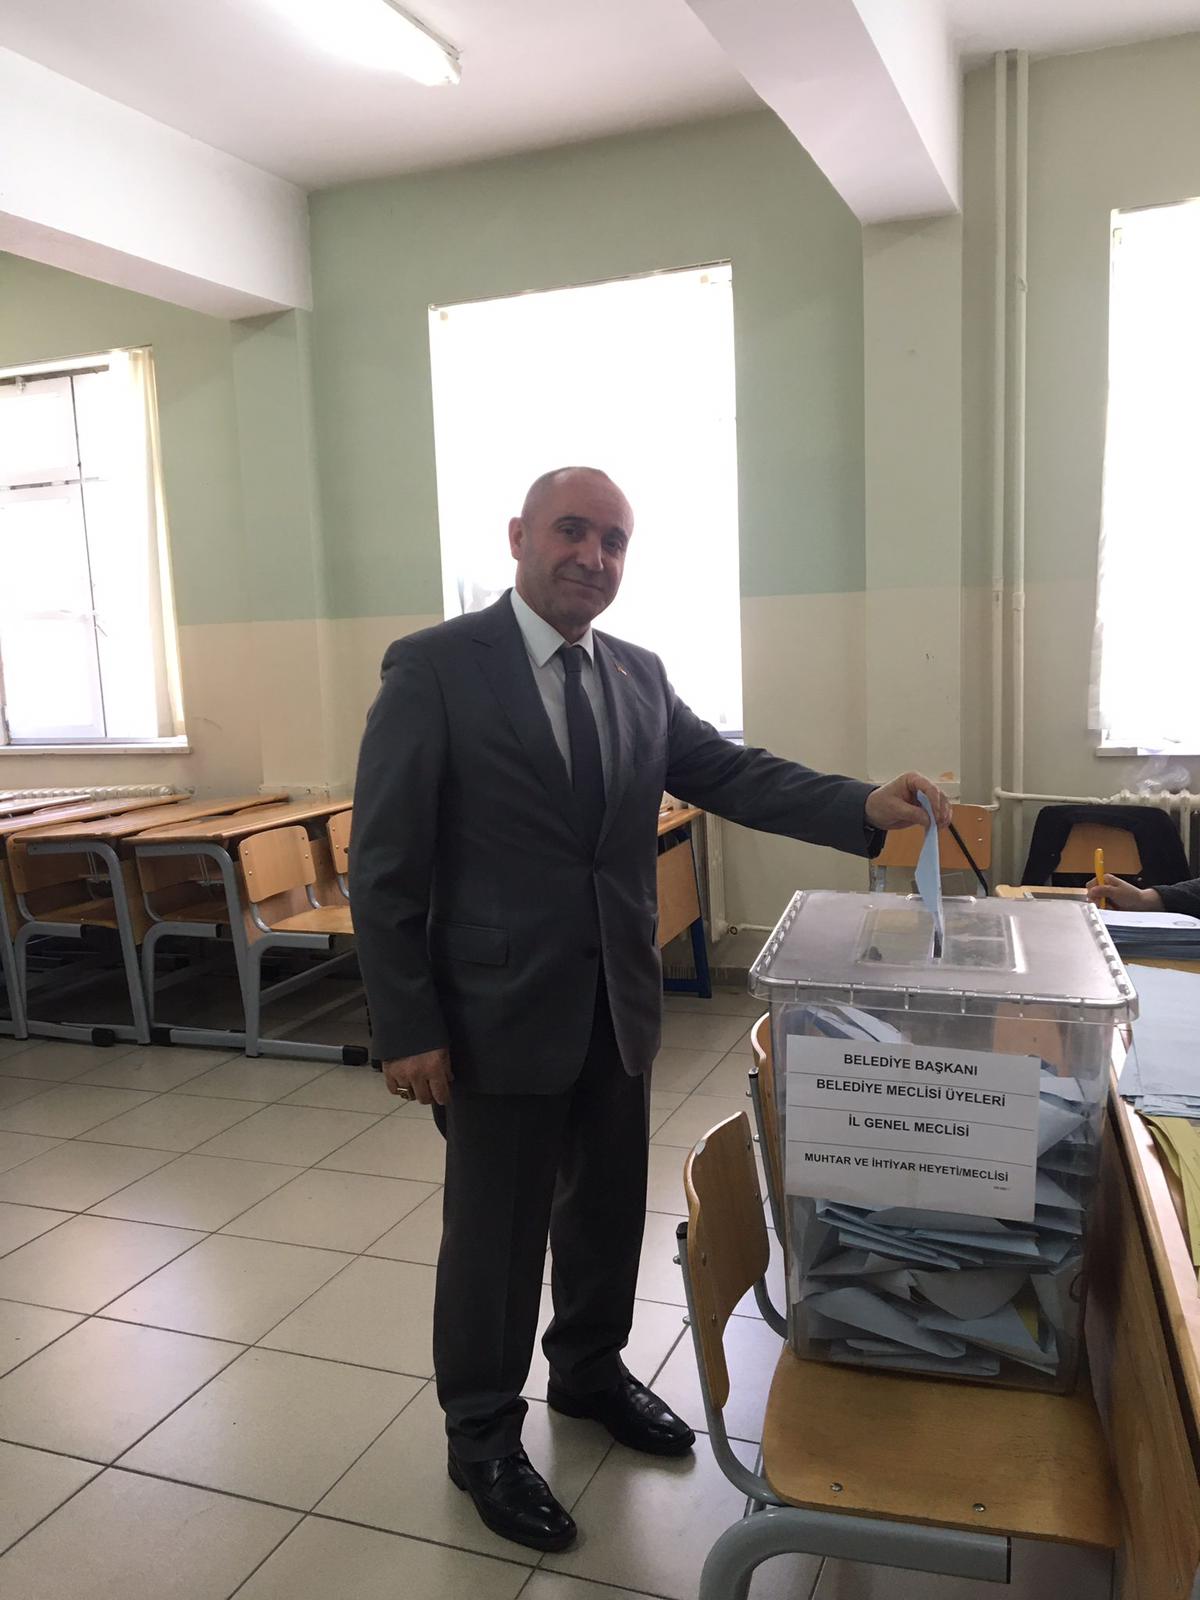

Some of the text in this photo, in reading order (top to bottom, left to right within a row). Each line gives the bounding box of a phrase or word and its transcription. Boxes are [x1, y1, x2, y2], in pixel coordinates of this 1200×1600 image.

[844, 1054, 978, 1077] BELEDİYE BAŞKANI
[817, 1079, 1006, 1107] BELEDİYE MECLİSİ ÜYELERİ
[848, 1114, 970, 1138] İL GENEL MECLİSİ
[805, 1153, 1009, 1182] MUHTAR VE İHTİYAR HEYETİ/MECLİSİ
